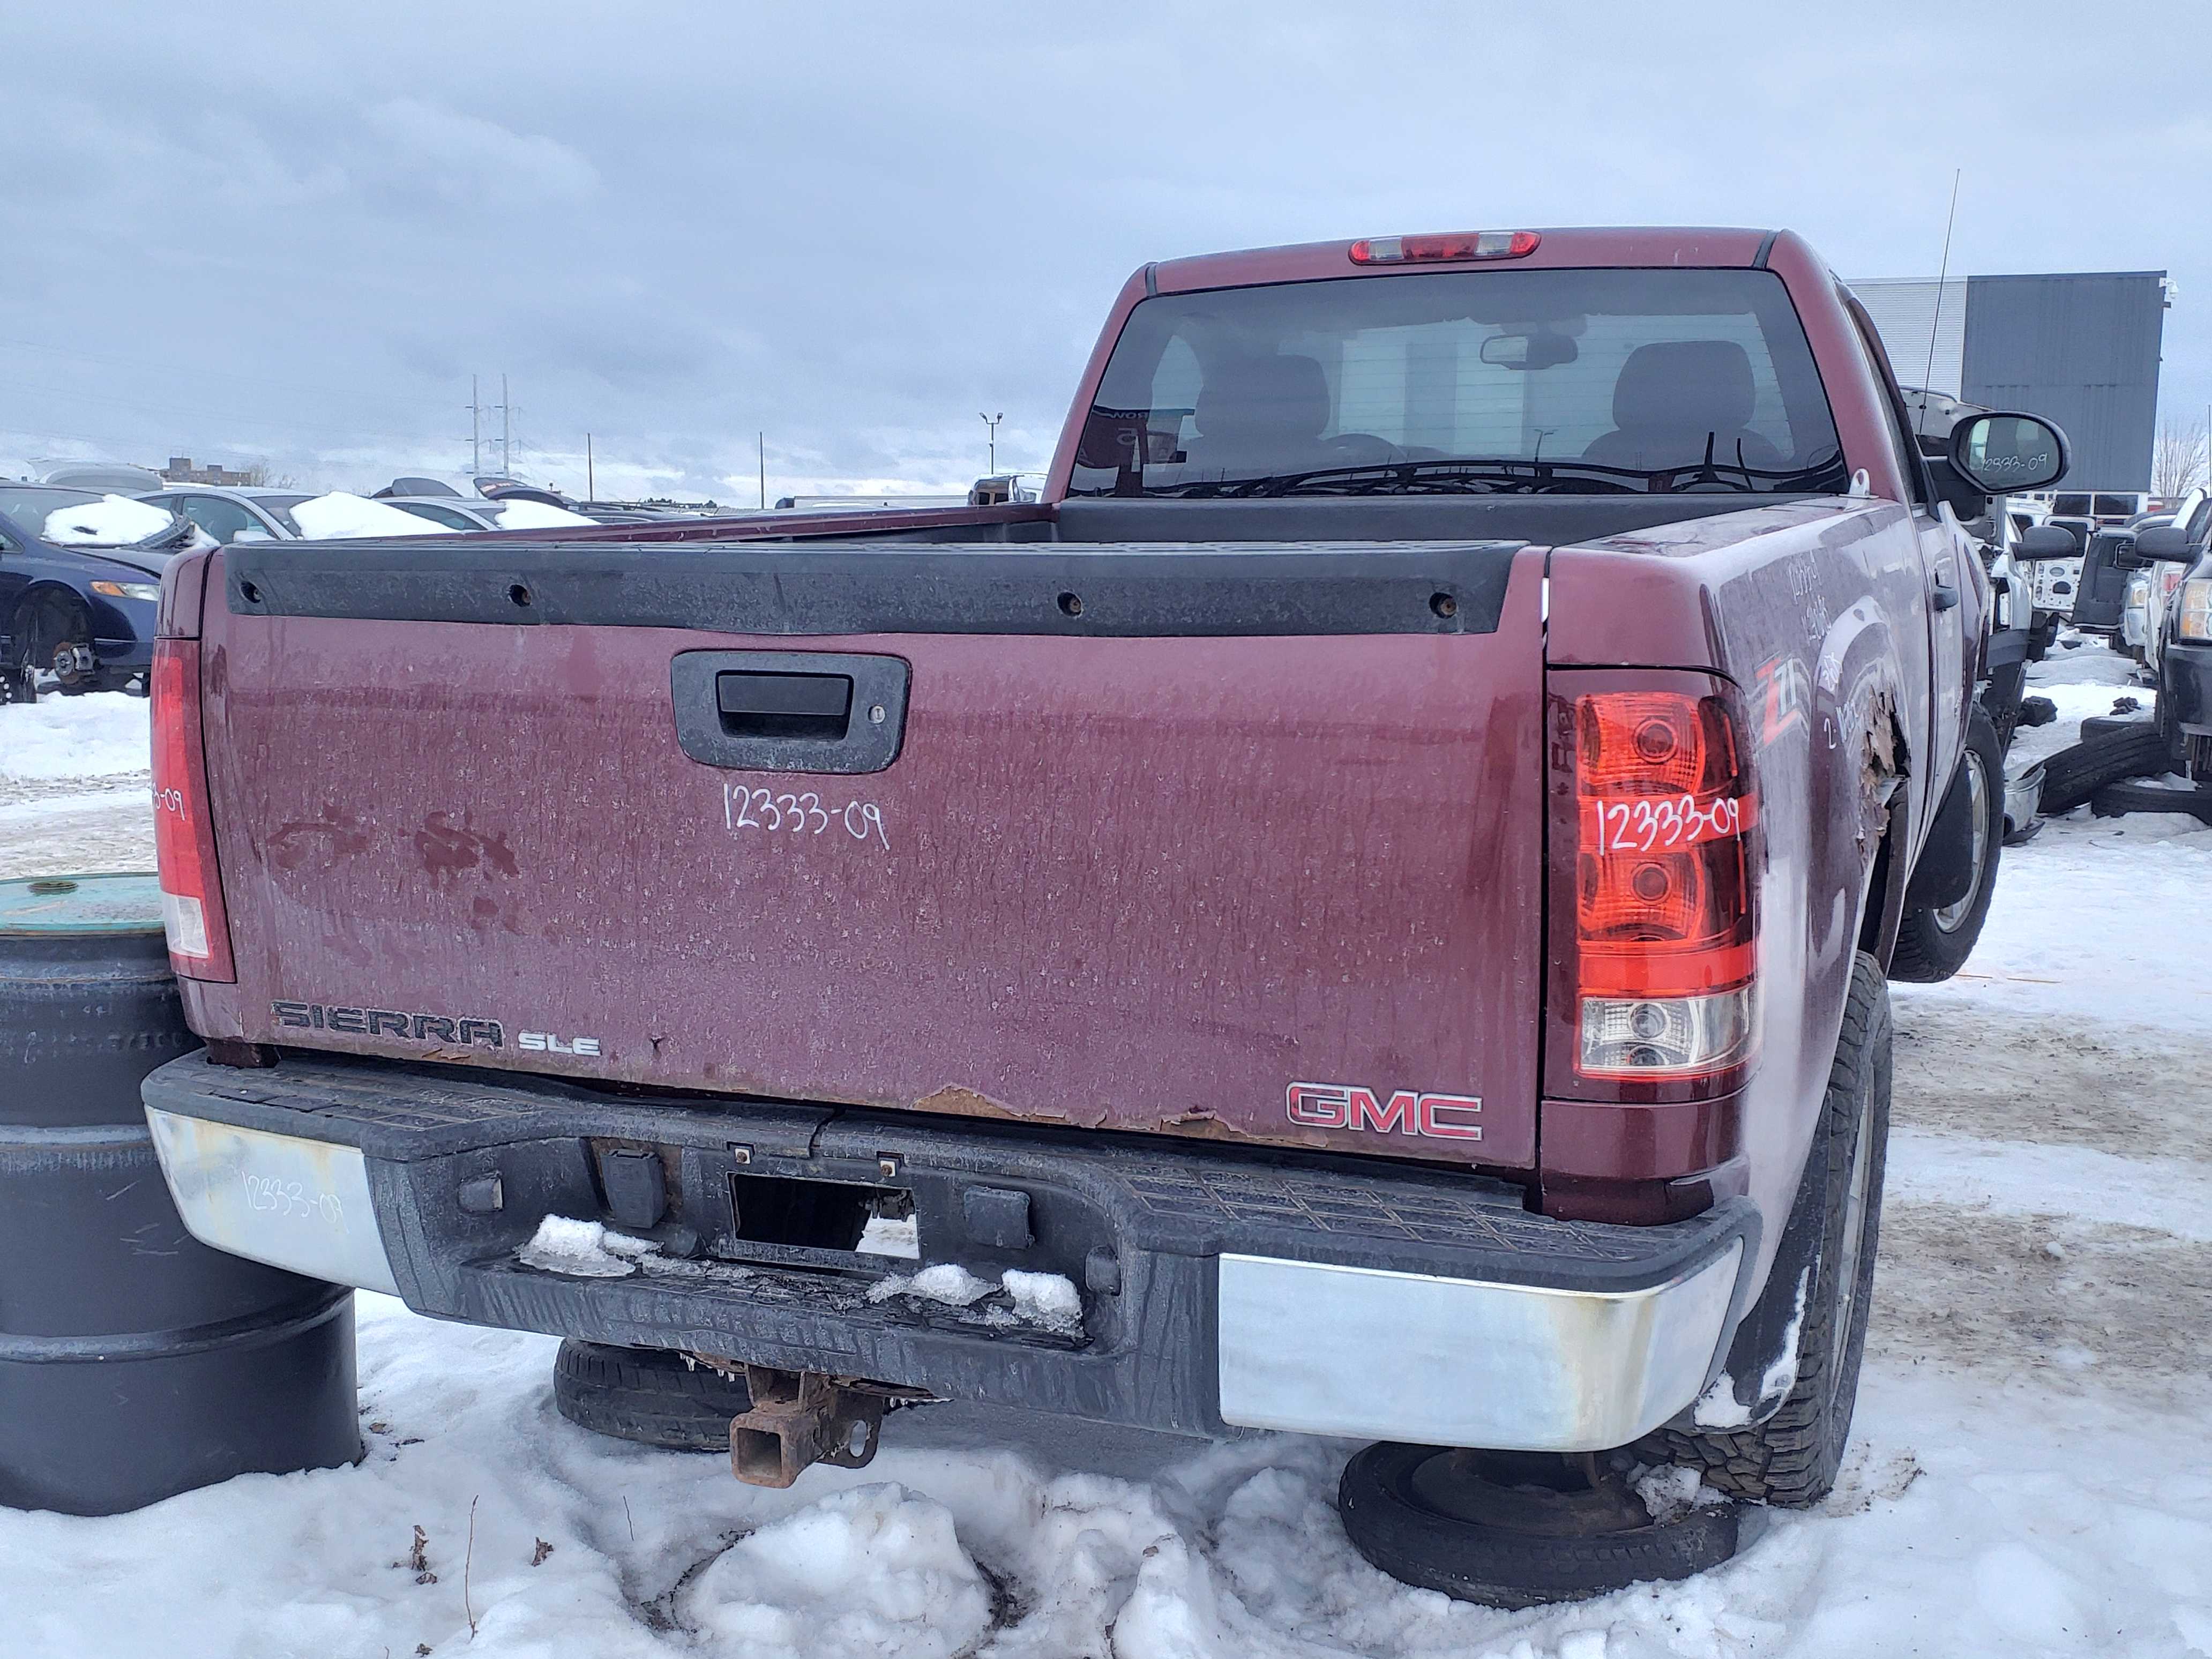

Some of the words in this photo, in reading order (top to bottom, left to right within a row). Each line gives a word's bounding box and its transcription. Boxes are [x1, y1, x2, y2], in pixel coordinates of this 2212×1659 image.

[1755, 657, 1799, 745] Z71
[152, 782, 186, 821] 3-09
[722, 783, 891, 851] 12333-09
[1597, 795, 1742, 856] 12333-09
[271, 999, 505, 1049] SIERRA
[517, 1031, 601, 1057] SLE
[1285, 1080, 1483, 1142] GMC
[240, 1170, 350, 1235] 12333-09
